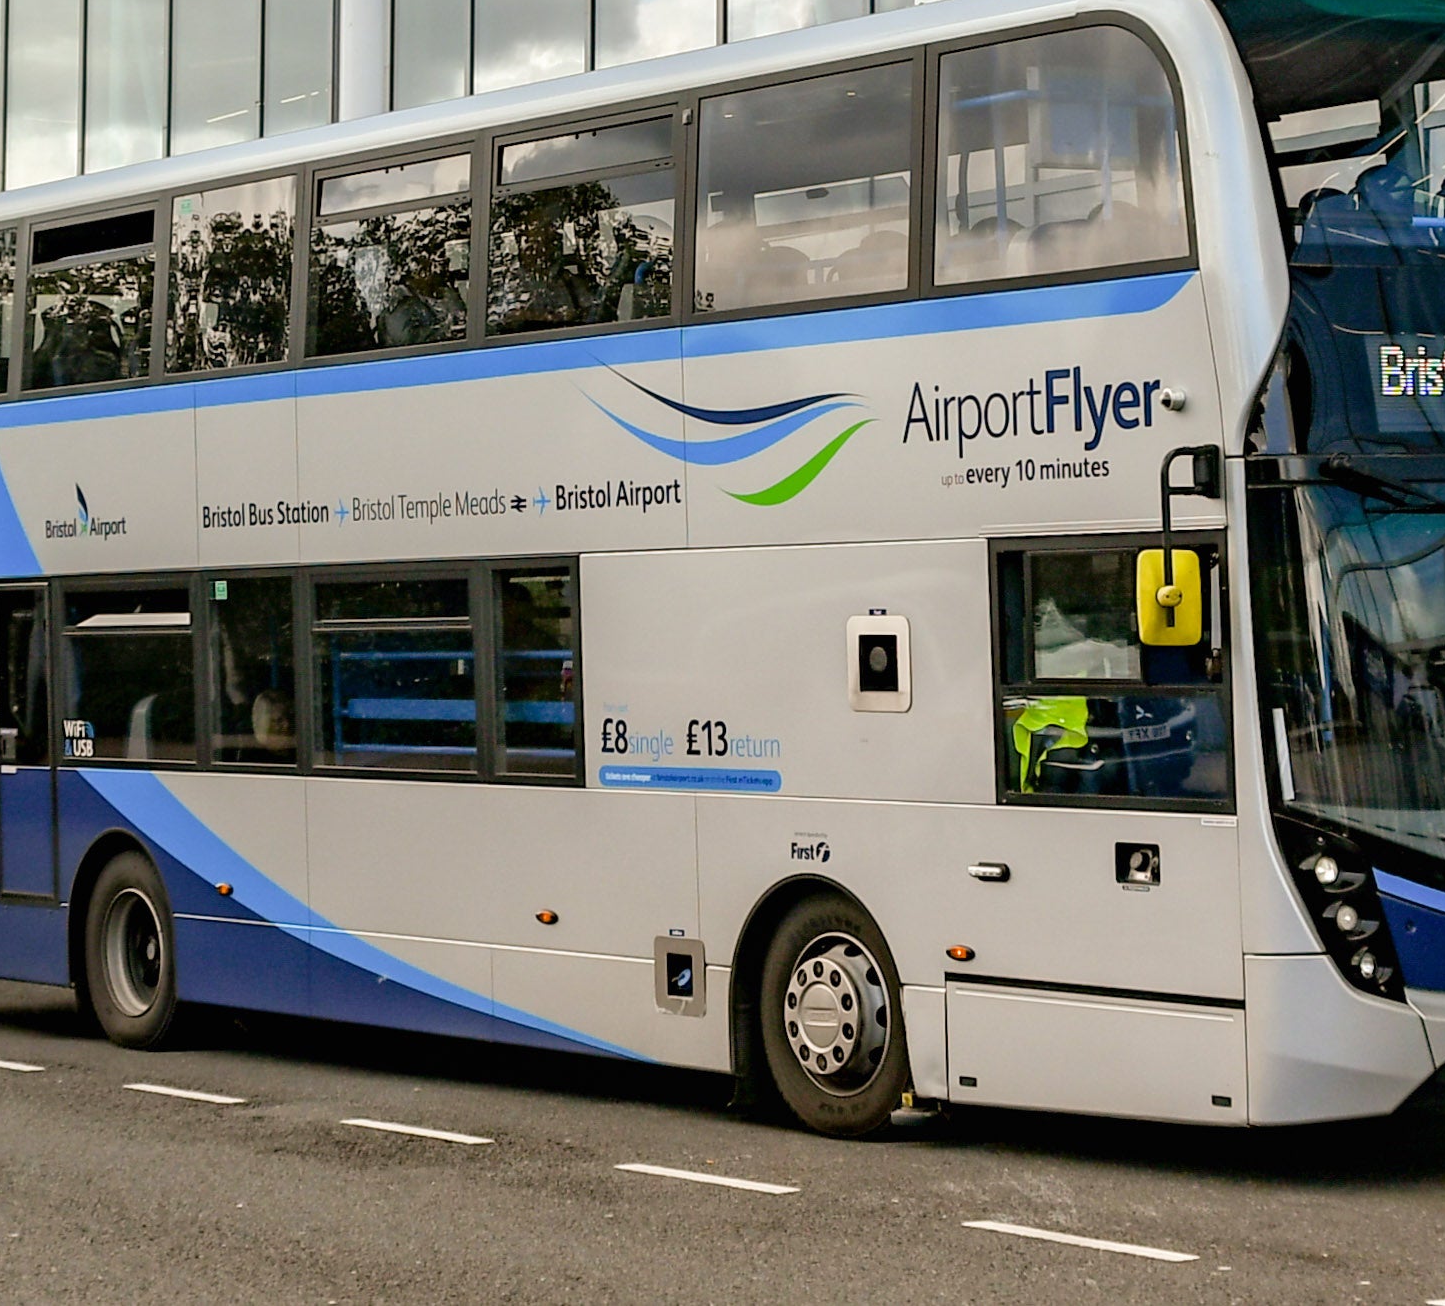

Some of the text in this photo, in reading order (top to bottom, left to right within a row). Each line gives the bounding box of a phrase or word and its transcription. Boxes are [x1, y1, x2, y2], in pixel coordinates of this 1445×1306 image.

[903, 366, 1161, 458] AirportFlyer
[941, 457, 1110, 488] up to every 10 minutes
[203, 479, 681, 529] Bristol Bus Station Bristol Temple Meads Bristol Airport
[45, 517, 127, 541] Bristol Airport
[63, 720, 86, 738] WiFi
[601, 718, 674, 762] £8 single
[686, 719, 781, 758] £13 return
[65, 739, 94, 757] & USB
[791, 842, 814, 860] First
